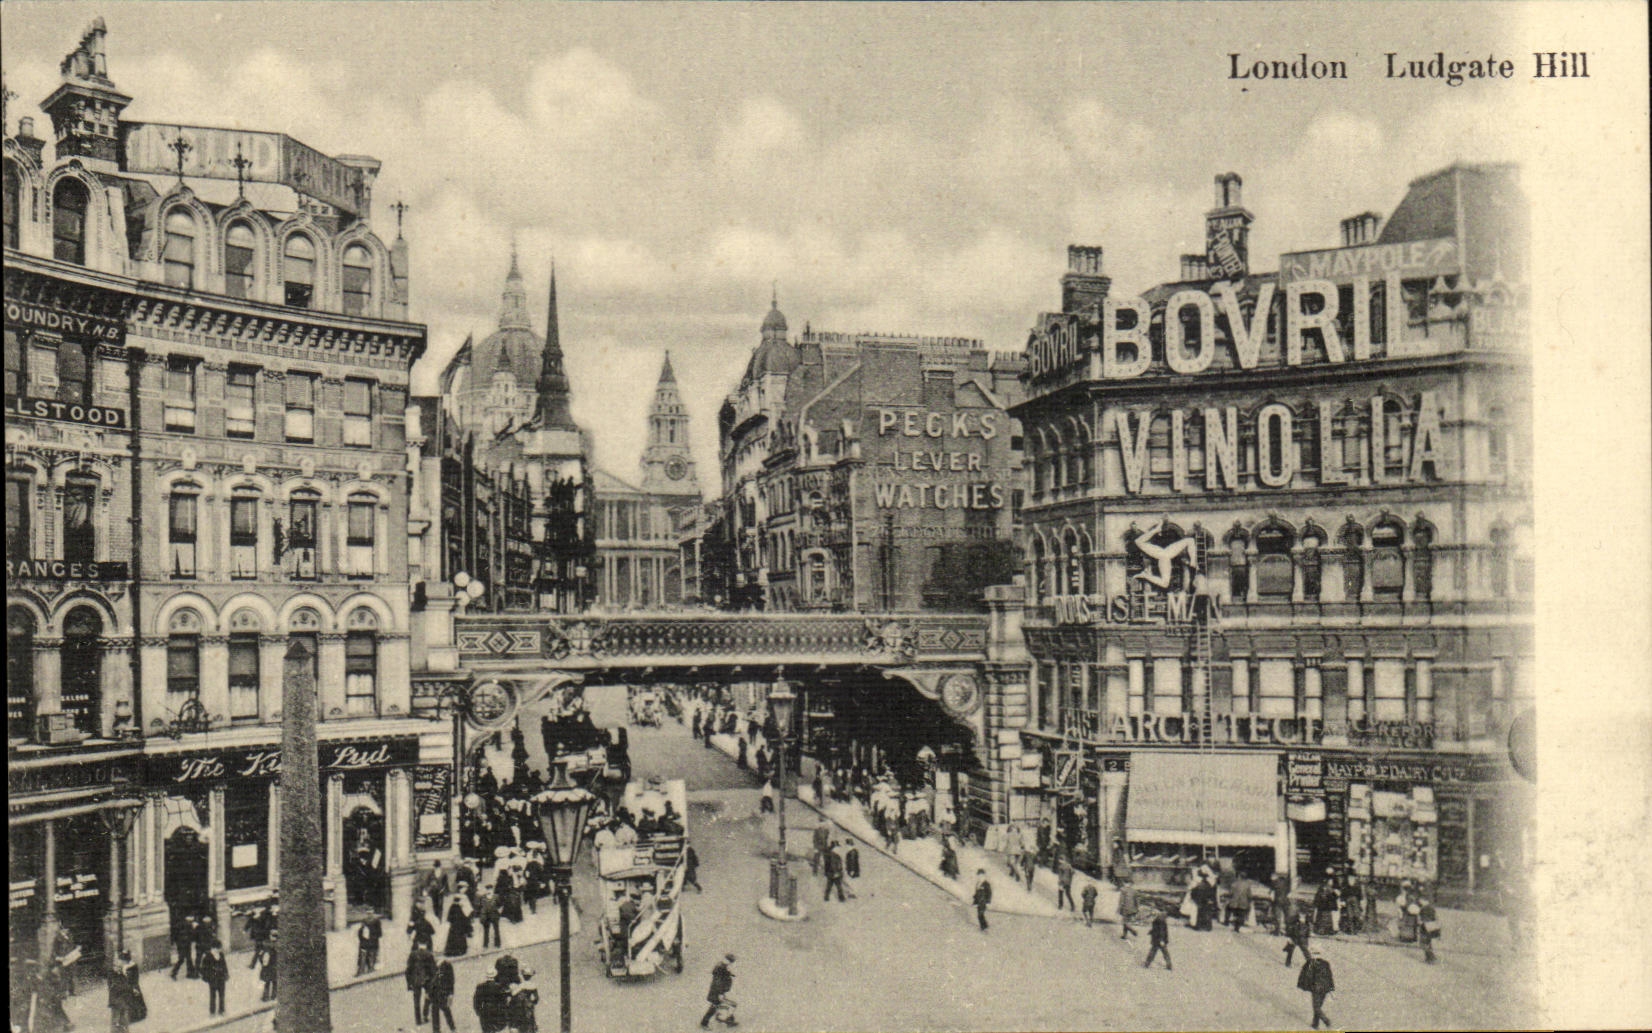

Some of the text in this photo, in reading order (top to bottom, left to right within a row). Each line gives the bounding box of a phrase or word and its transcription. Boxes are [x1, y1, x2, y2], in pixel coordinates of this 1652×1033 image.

[1308, 243, 1426, 278] MAYPOLE
[5, 303, 90, 334] OUNDRY.
[1102, 270, 1442, 378] BOVRIL
[1032, 321, 1083, 377] BOVRIL
[1115, 391, 1442, 492] VINOLIA
[894, 451, 981, 471] LEVER
[875, 483, 1004, 509] WATCHES
[173, 757, 225, 783] The
[328, 744, 392, 769] Lud
